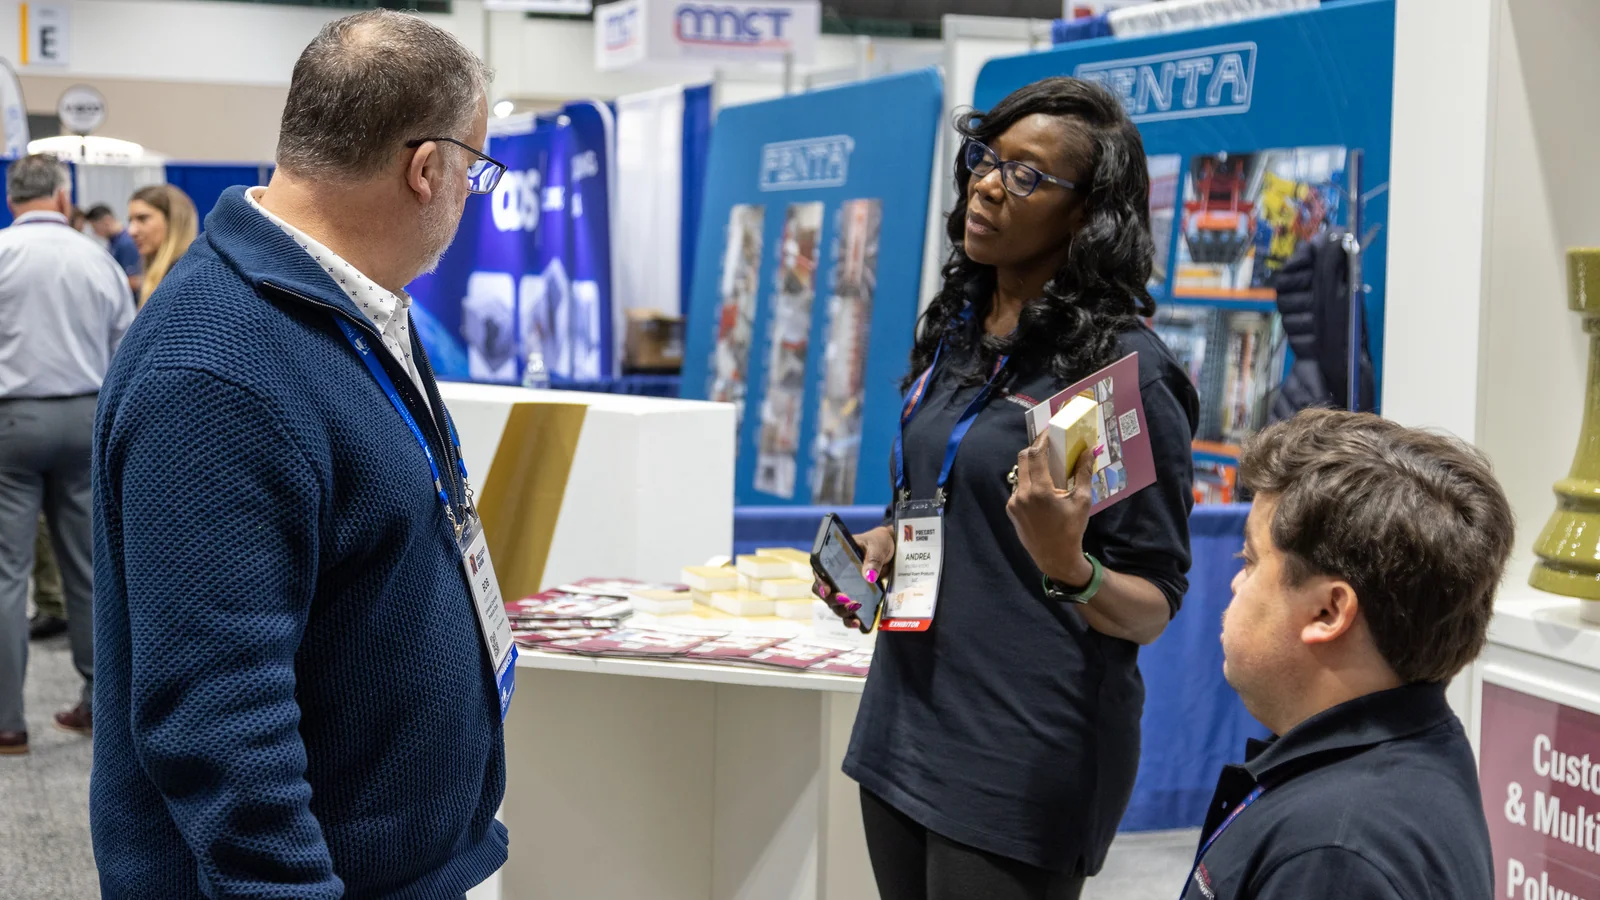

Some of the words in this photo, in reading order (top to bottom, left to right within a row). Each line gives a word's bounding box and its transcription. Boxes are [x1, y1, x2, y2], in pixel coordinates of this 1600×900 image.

[40, 25, 57, 59] E
[1080, 53, 1248, 114] ENTA
[764, 143, 846, 184] PENTA
[905, 552, 931, 561] ANDREA
[889, 620, 920, 628] EXHIBITOR
[1504, 781, 1527, 826] &
